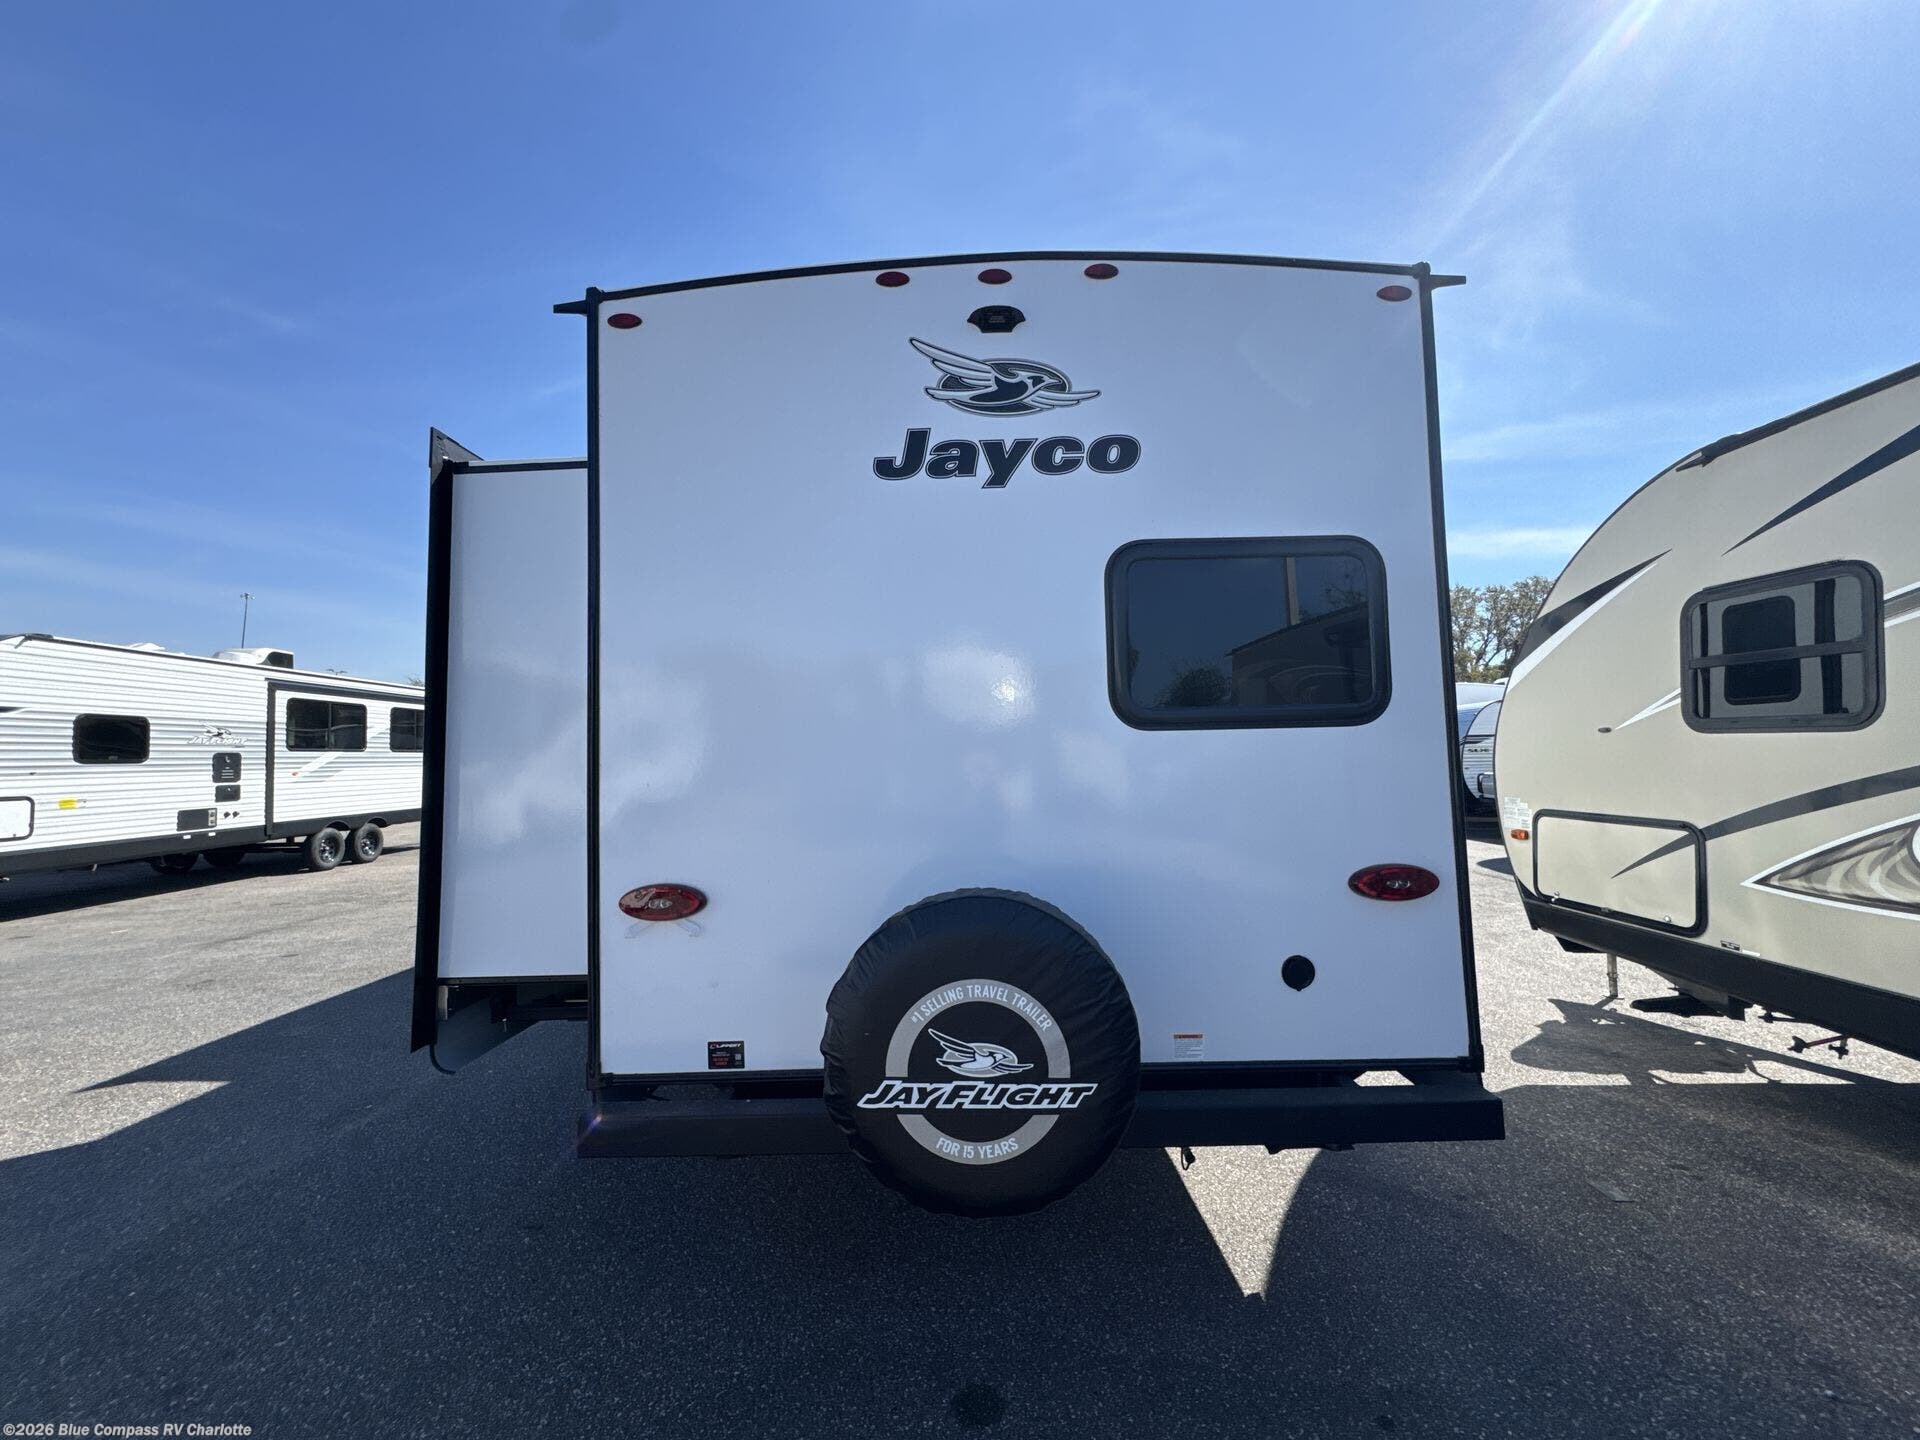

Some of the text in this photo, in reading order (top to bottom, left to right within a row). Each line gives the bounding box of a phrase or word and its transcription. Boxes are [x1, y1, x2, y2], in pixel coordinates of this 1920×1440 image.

[872, 427, 1142, 489] Jayco
[910, 984, 1053, 1033] #1 SELLING TRAVEL TRAILER
[936, 1137, 1019, 1159] FOR 15 YEARS
